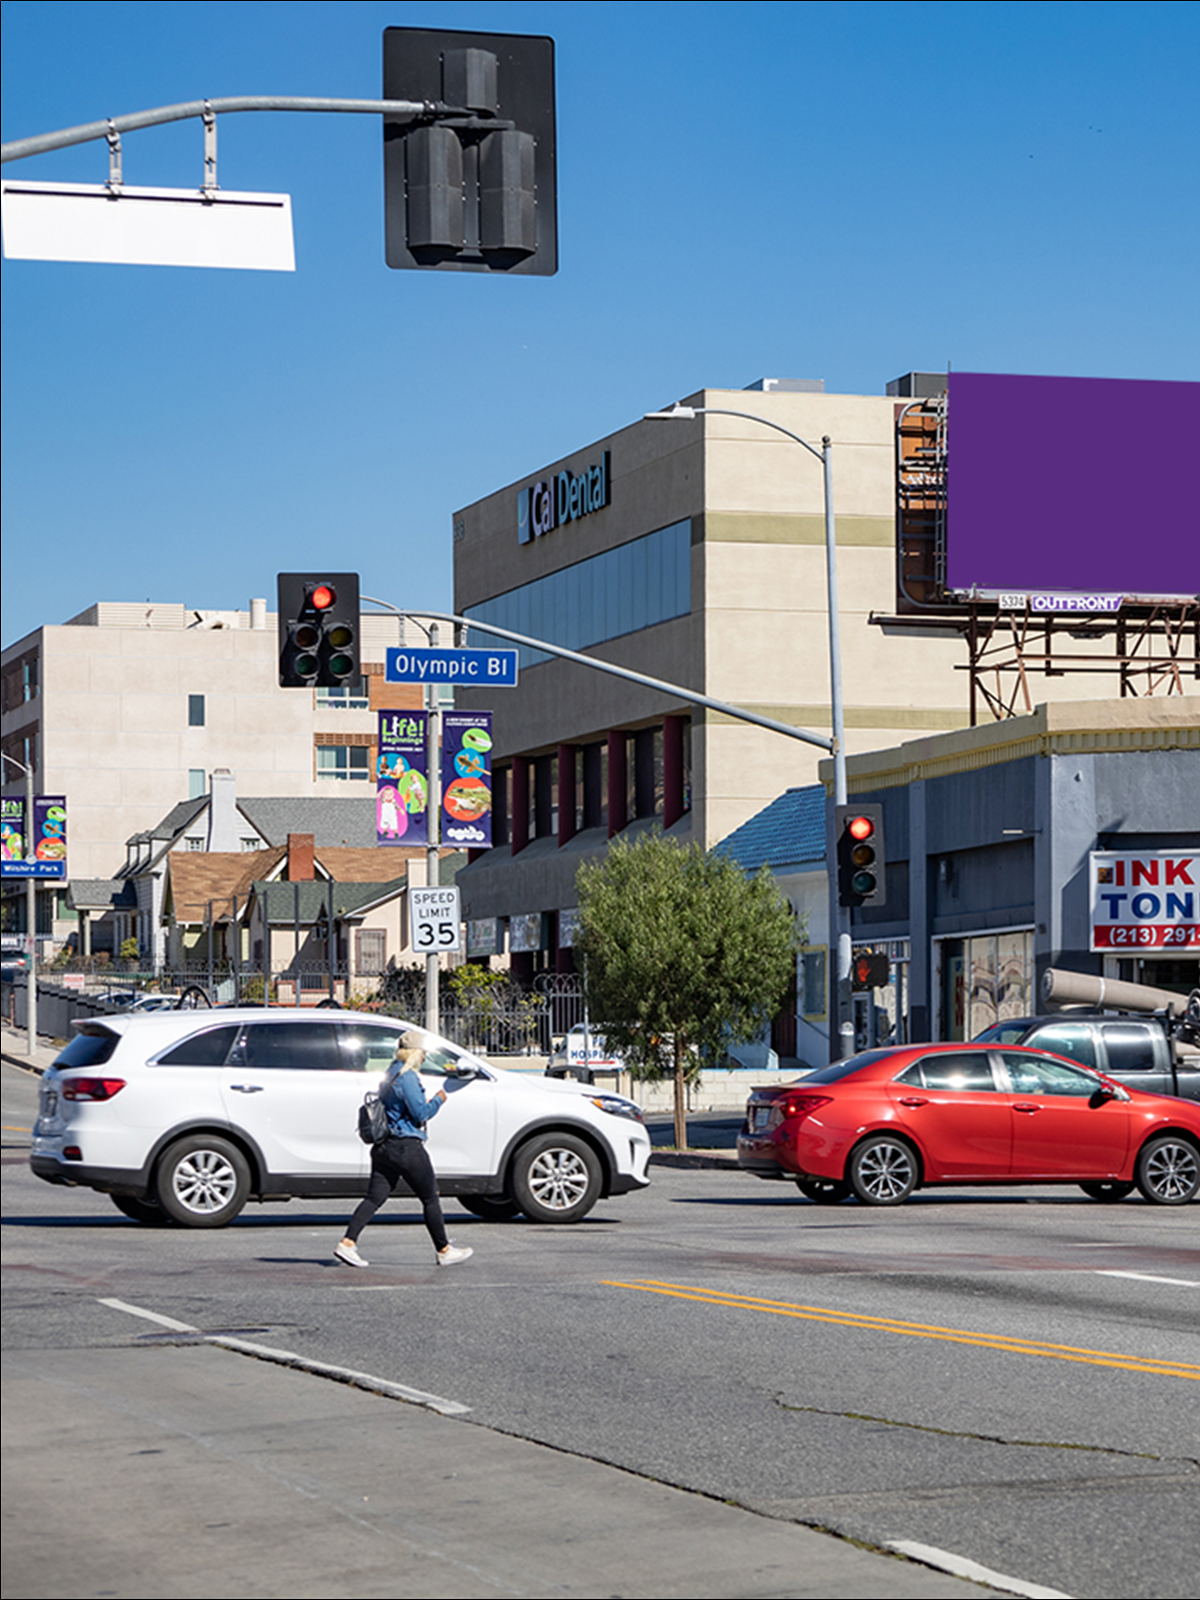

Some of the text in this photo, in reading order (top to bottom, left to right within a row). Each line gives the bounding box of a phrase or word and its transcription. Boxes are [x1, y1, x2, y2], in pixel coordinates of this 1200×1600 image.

[531, 451, 606, 537] Cal Dental
[1035, 596, 1118, 609] OUTFRONT
[395, 654, 507, 678] Olympic Bl
[39, 864, 59, 872] Park
[1115, 858, 1195, 886] INK
[414, 892, 455, 904] SPEED
[419, 907, 450, 918] LIMIT
[418, 922, 455, 946] 35
[1109, 927, 1157, 945] (213)
